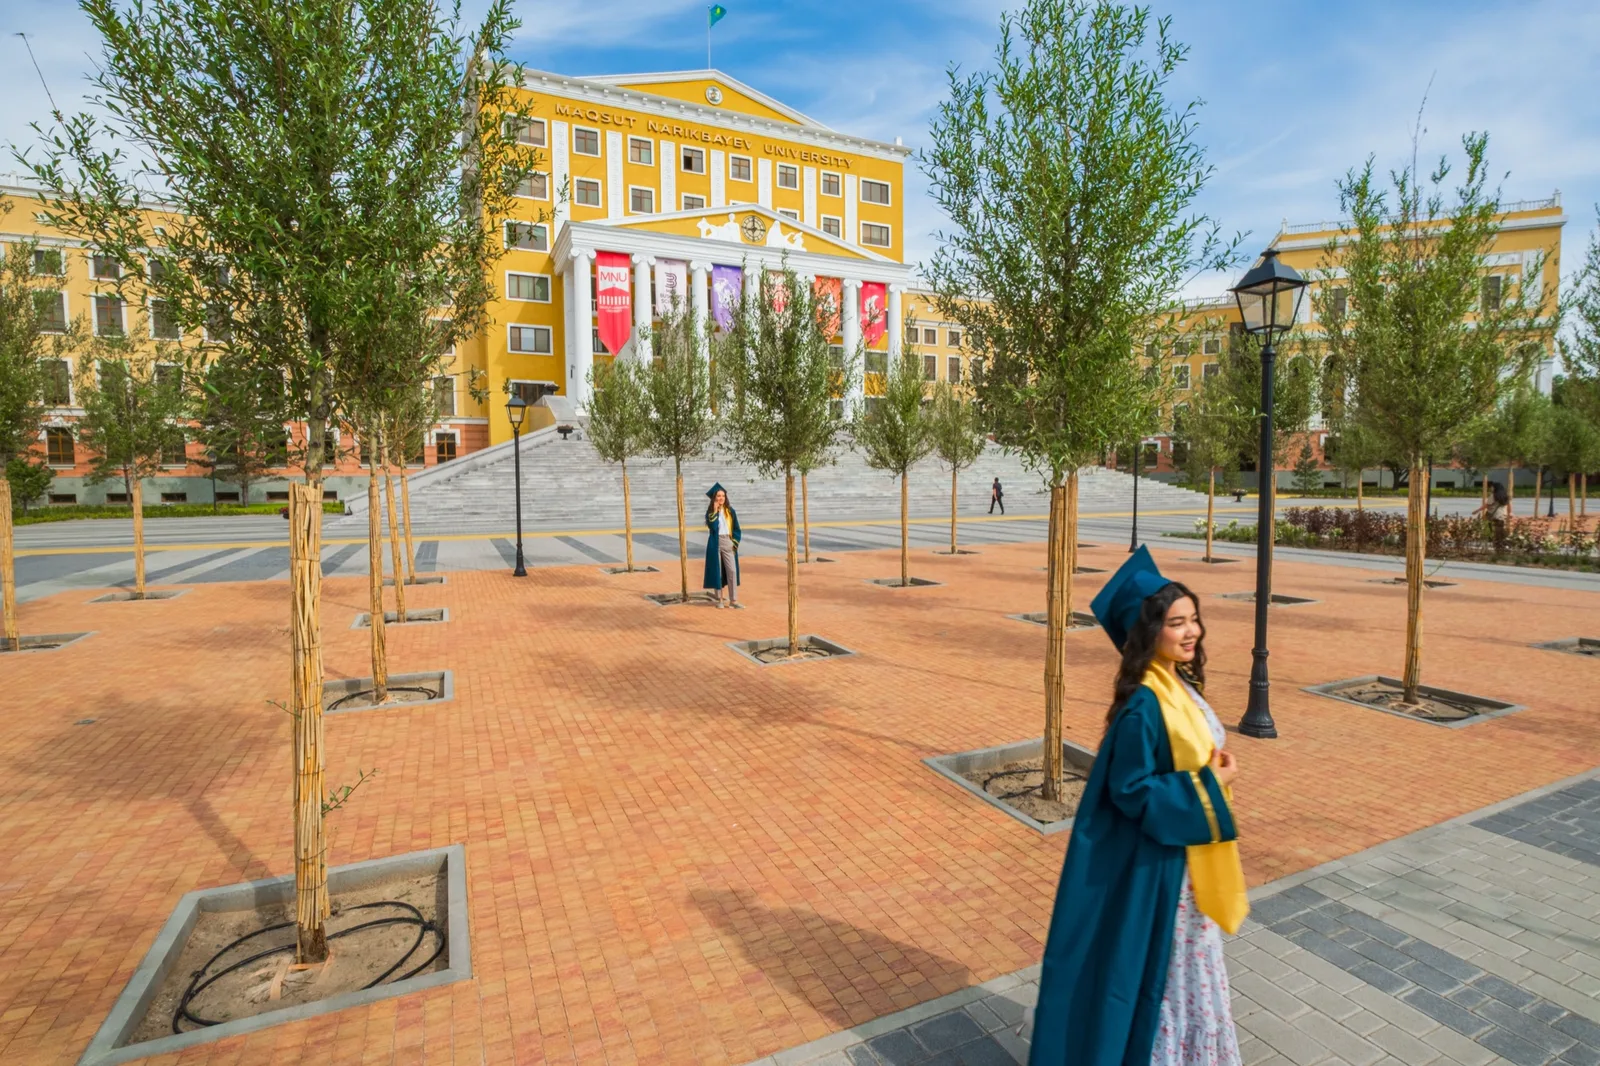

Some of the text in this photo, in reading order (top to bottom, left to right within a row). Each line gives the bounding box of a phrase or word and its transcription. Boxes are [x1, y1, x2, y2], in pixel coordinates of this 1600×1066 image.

[555, 103, 853, 168] MAQSUT NARIKBAYEV UNIVERSITY
[600, 271, 627, 282] MNU
